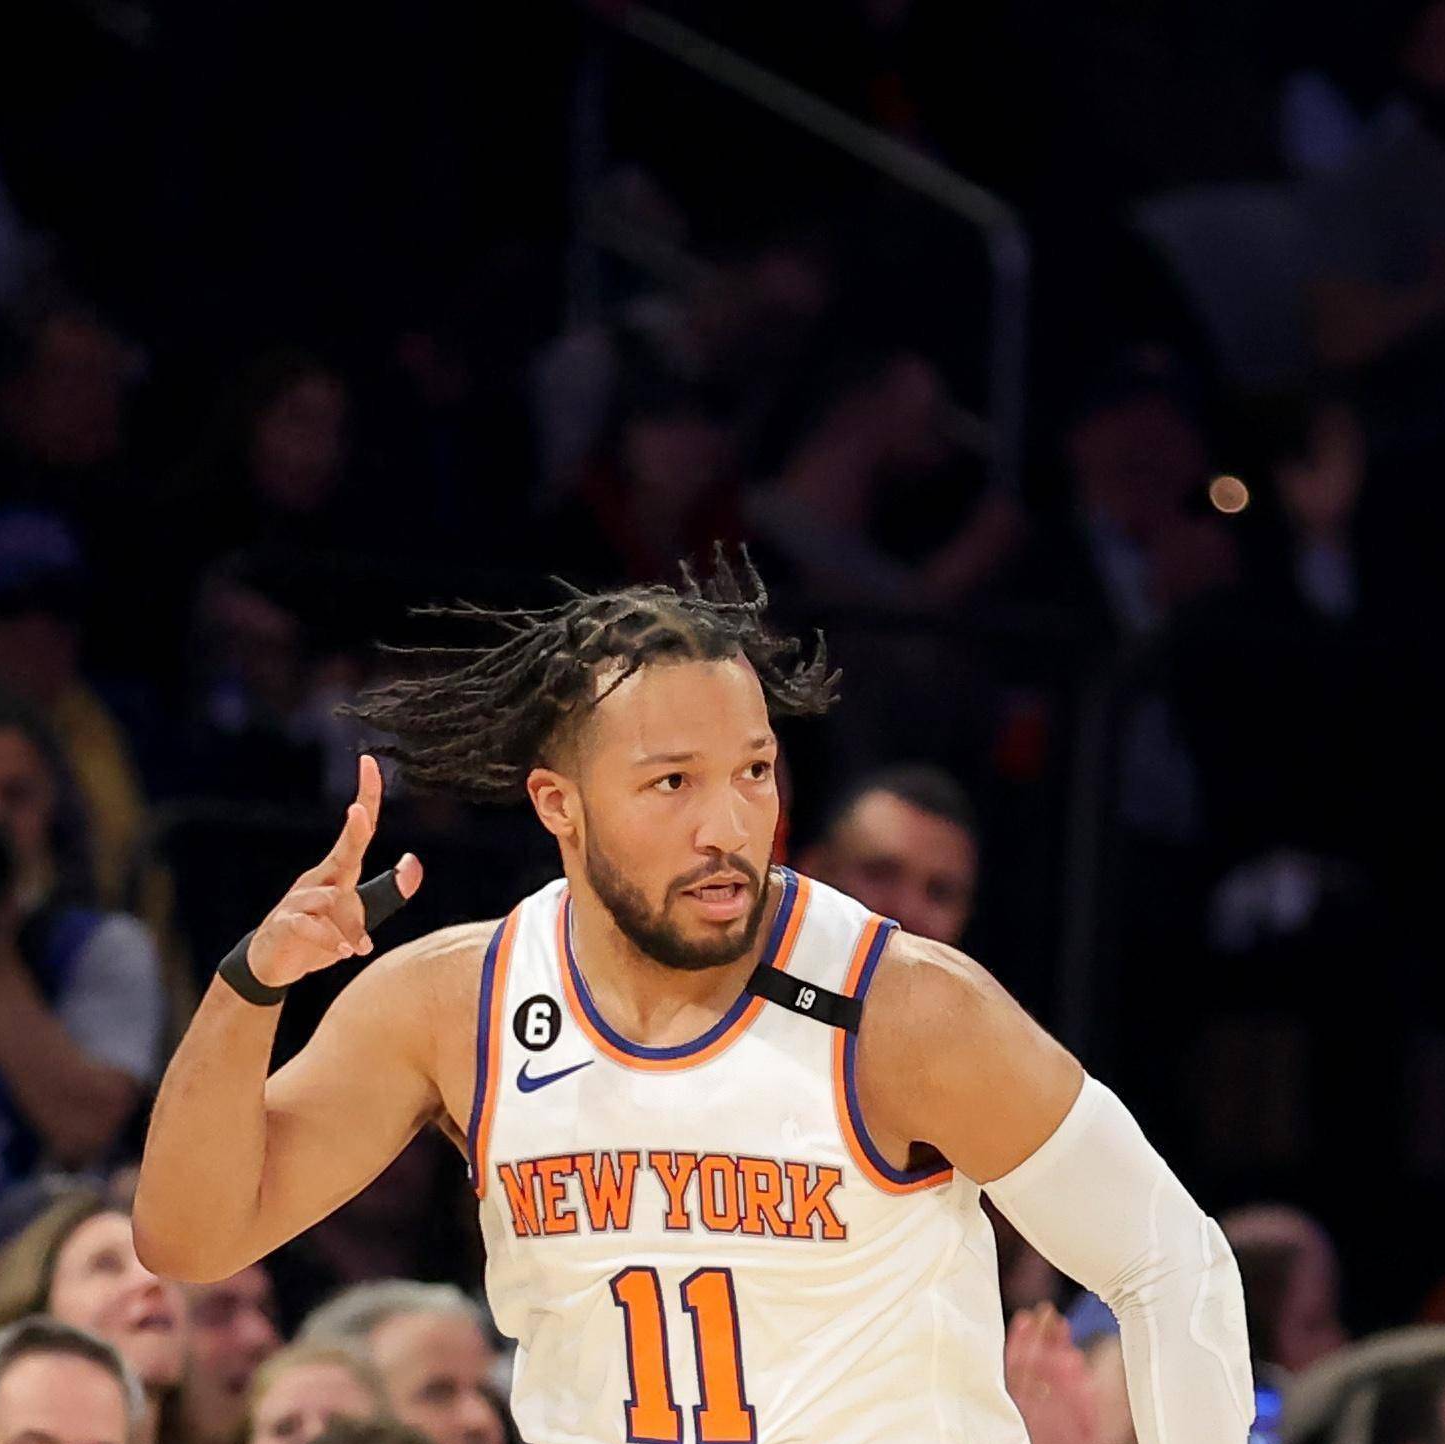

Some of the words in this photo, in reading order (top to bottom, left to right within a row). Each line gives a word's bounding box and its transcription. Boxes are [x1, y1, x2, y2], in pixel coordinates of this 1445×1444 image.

[795, 986, 817, 1010] 19
[527, 1002, 552, 1045] 6
[497, 1150, 642, 1240] NEW
[649, 1150, 849, 1242] YORK
